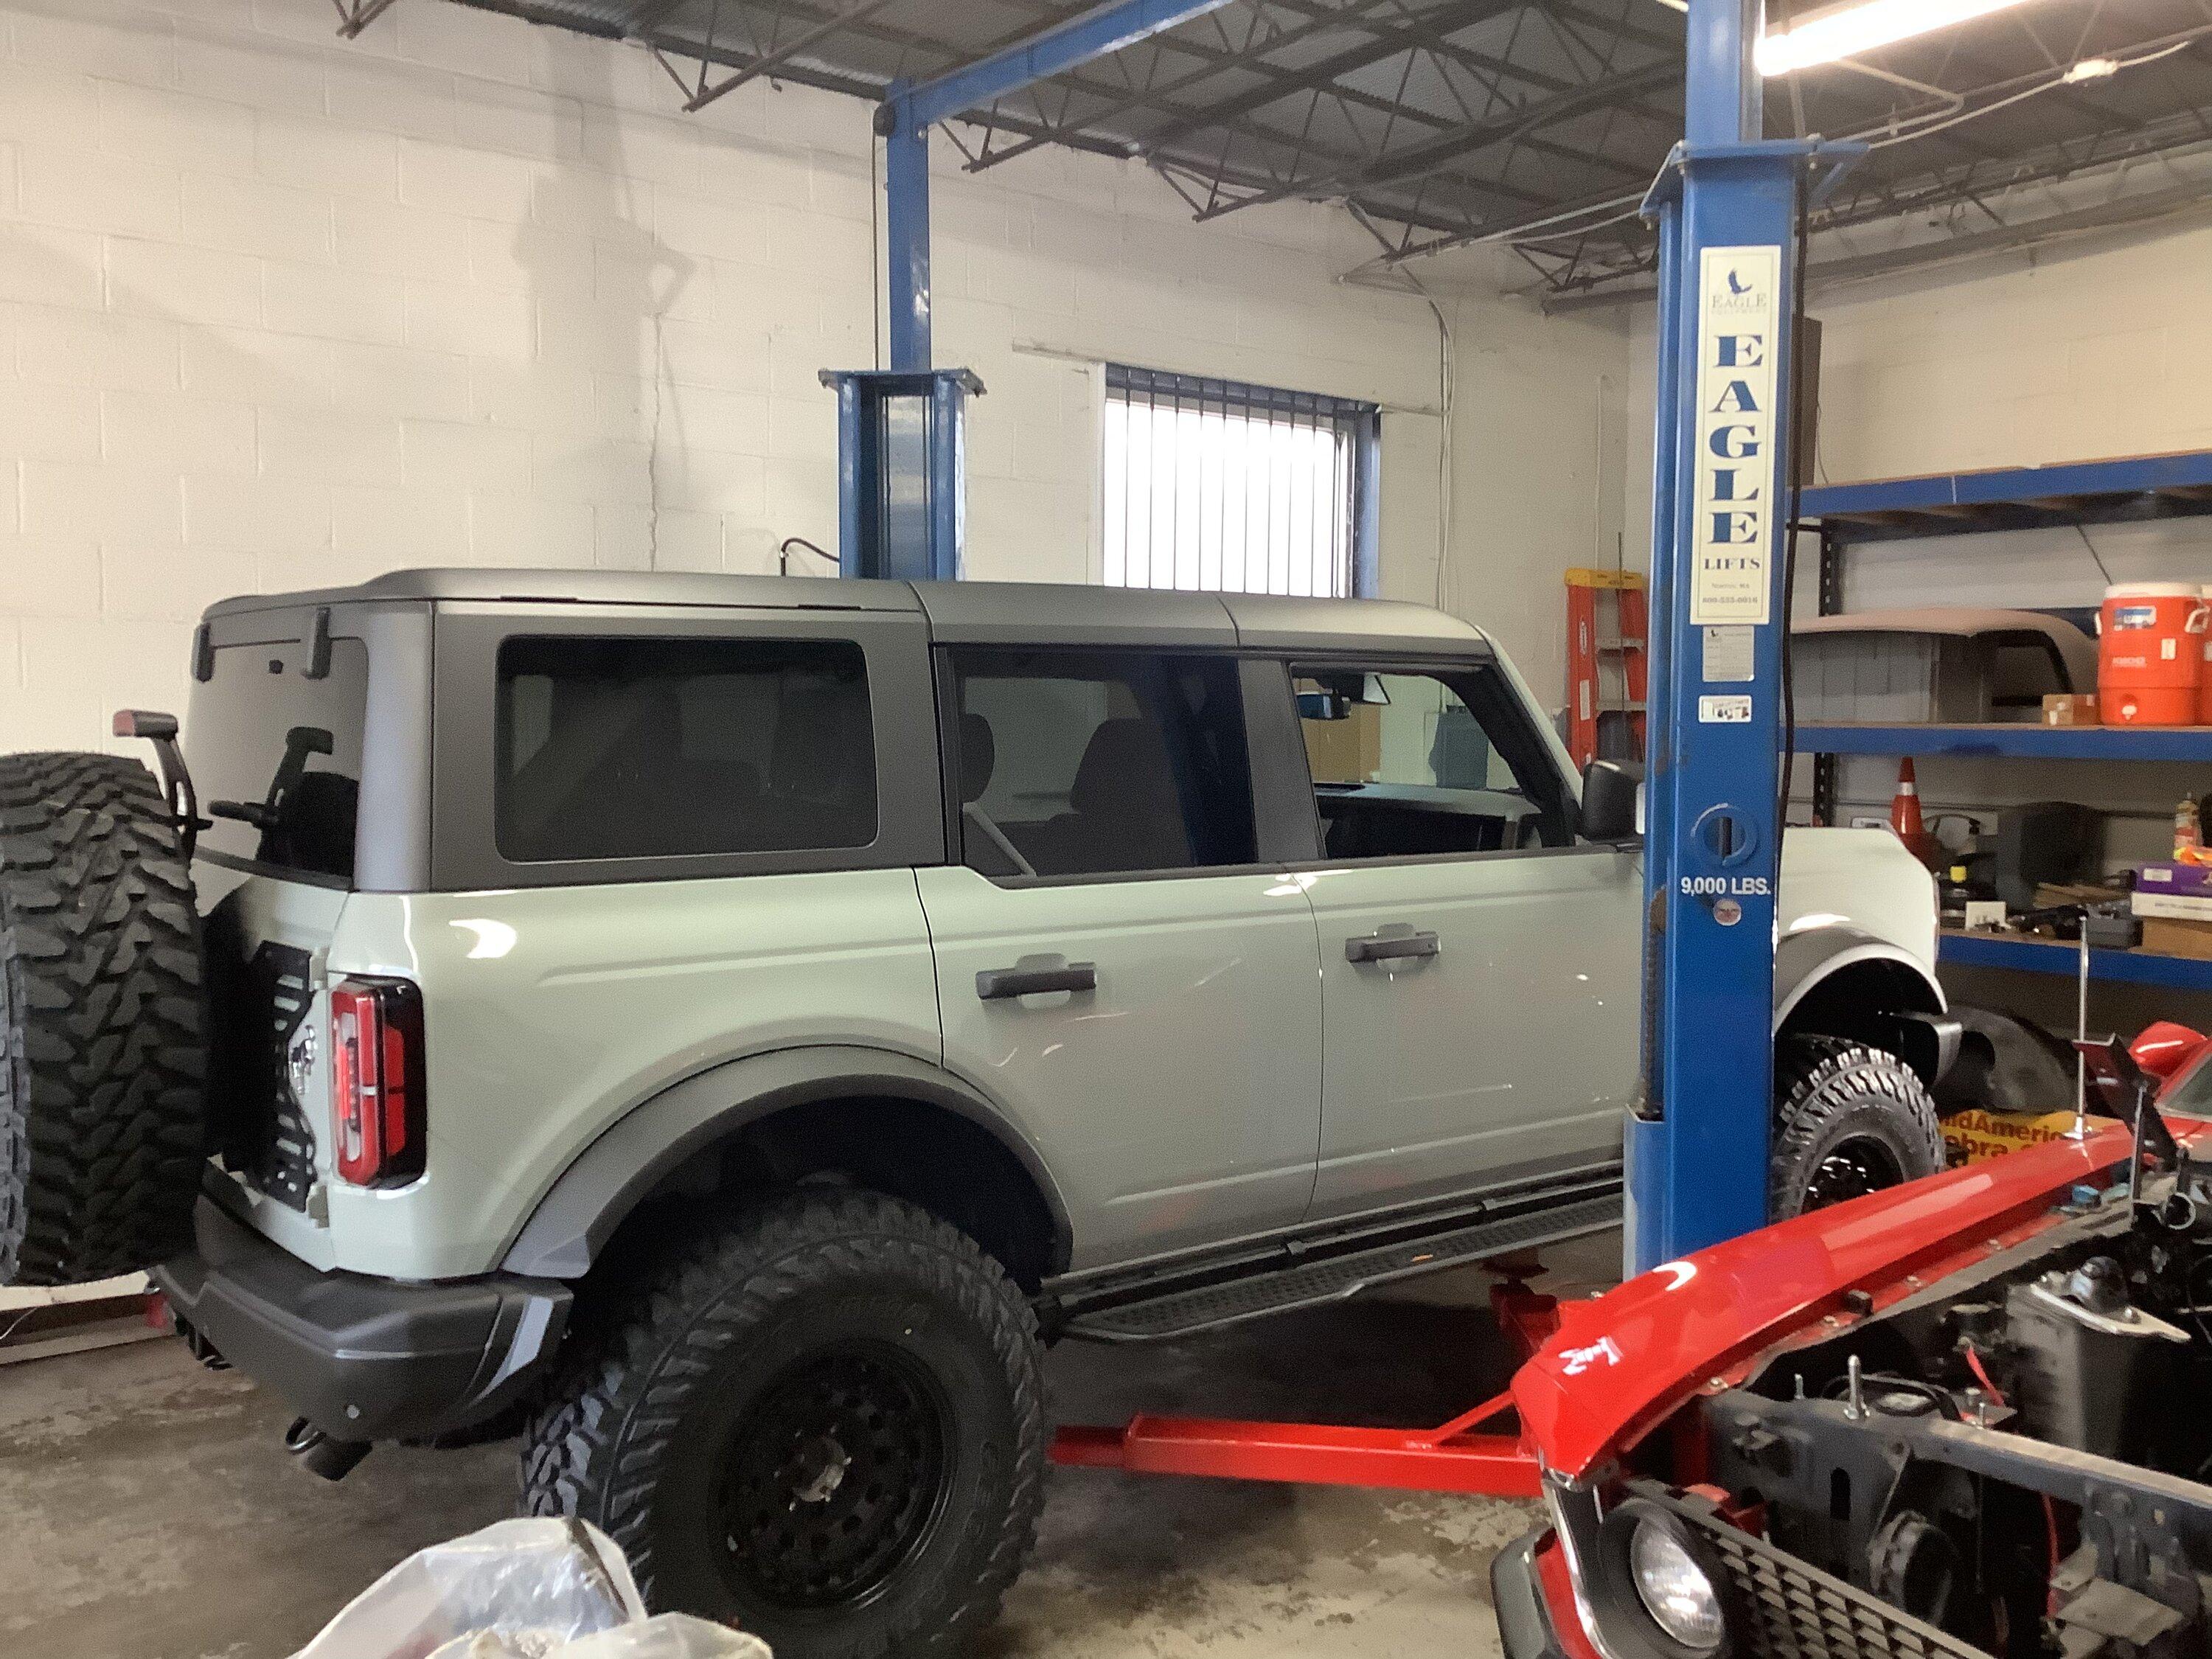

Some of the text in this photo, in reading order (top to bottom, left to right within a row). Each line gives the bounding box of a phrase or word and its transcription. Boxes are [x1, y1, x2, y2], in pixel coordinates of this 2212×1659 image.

[1712, 293, 1767, 308] EAGLE
[1707, 334, 1763, 544] EAGLE
[1704, 557, 1760, 570] LIFTS
[1680, 877, 1771, 897] 9,000 LBS.
